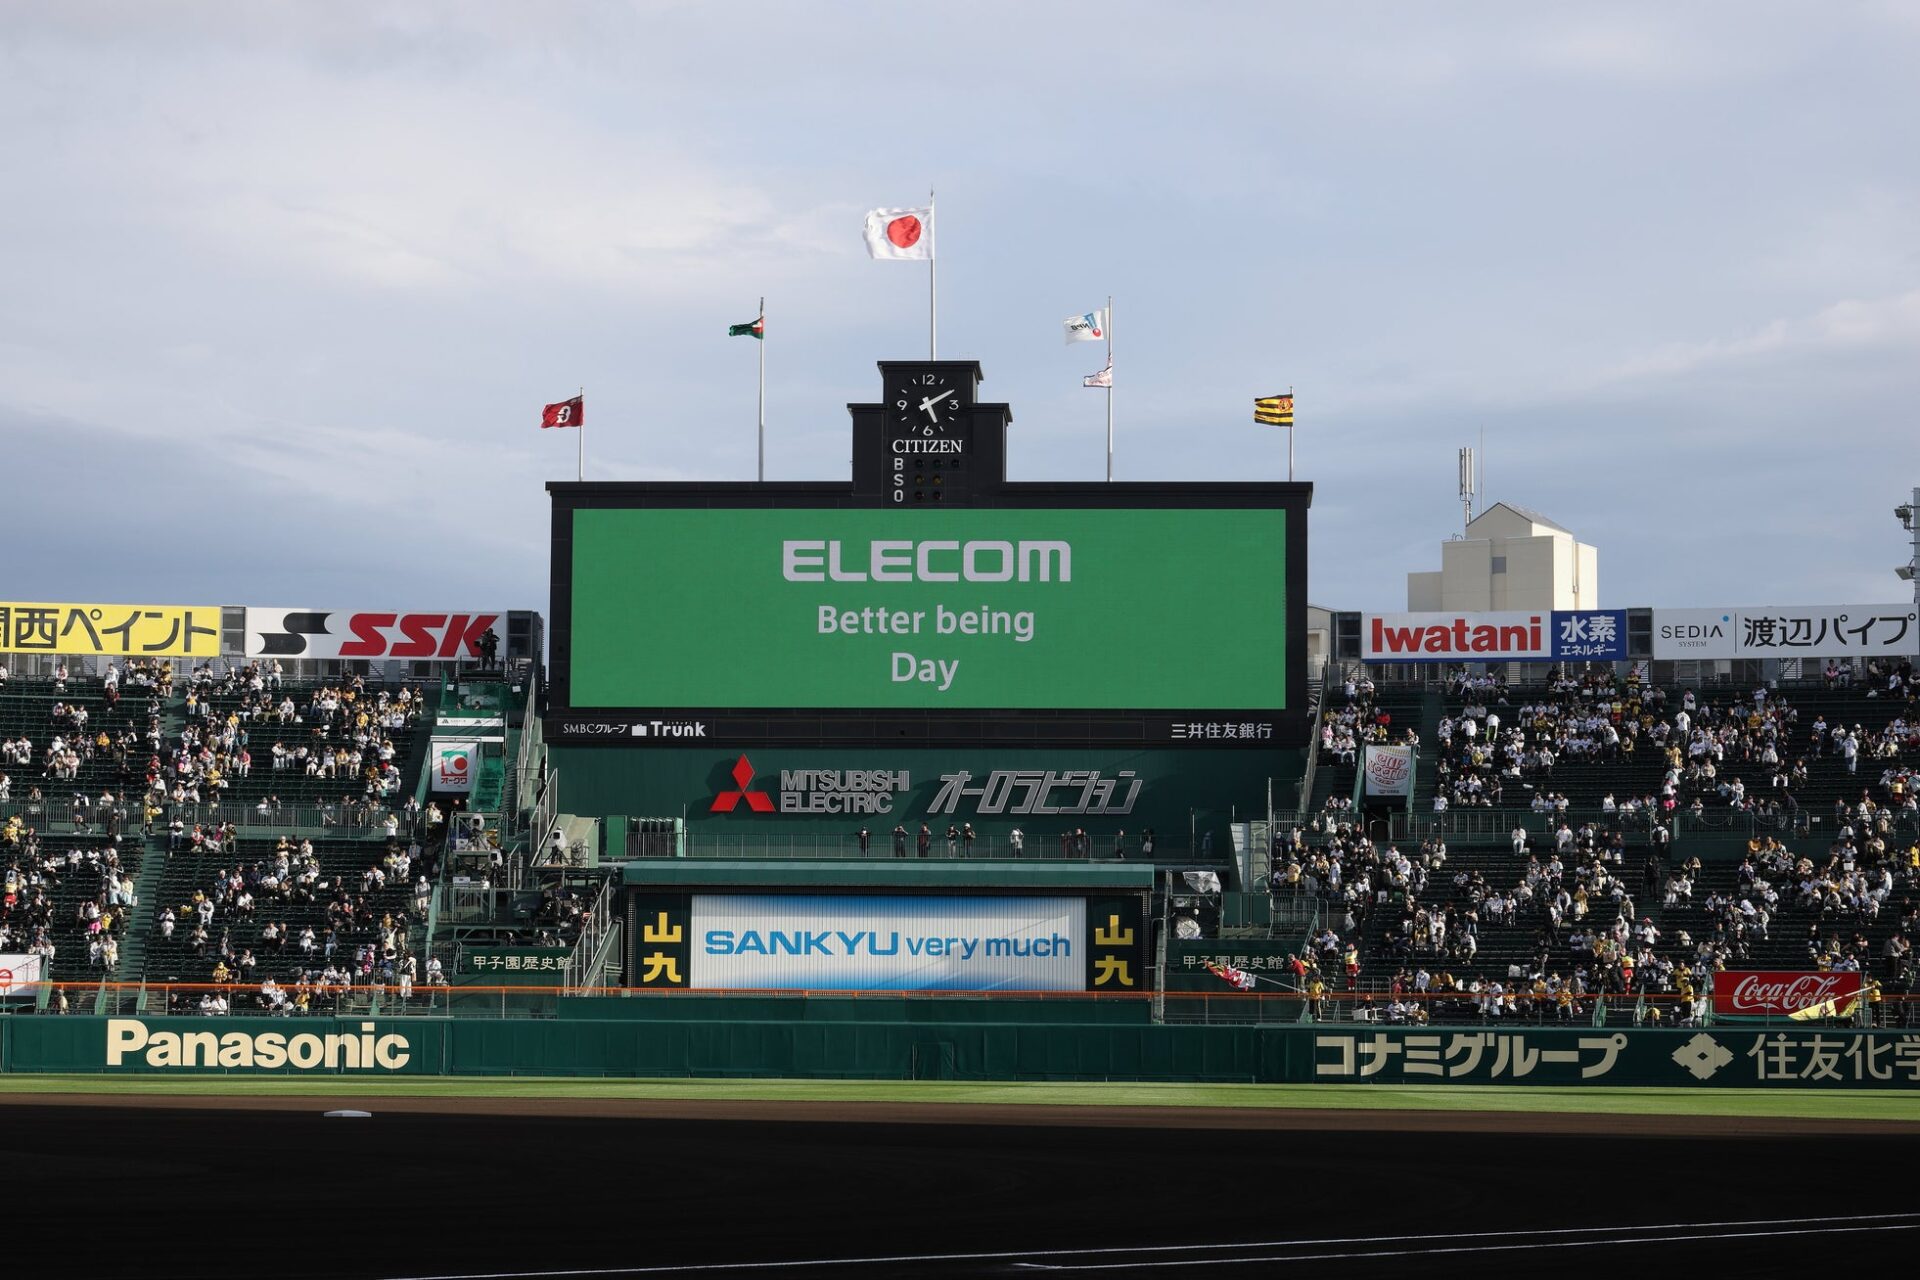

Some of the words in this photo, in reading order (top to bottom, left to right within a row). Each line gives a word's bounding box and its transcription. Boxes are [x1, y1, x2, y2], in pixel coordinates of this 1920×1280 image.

[922, 374, 935, 385] 12
[897, 400, 907, 410] 9
[949, 400, 959, 410] 3
[923, 426, 933, 436] 6
[892, 439, 963, 453] CITIZEN
[894, 458, 904, 470] B
[894, 474, 904, 486] S
[783, 540, 1071, 582] ELECOM
[0, 607, 217, 653] 西ペイント
[339, 613, 499, 657] SSK
[818, 606, 925, 634] Better
[936, 604, 1034, 642] being
[1372, 616, 1541, 653] Iwatani
[1561, 615, 1616, 642] 水素
[1661, 625, 1723, 639] SEDIA
[1744, 613, 1917, 648] 渡辺パイプ
[1560, 644, 1616, 656] エネルギー
[892, 652, 959, 691] Day
[563, 724, 628, 734] SMBCグループ
[650, 721, 706, 737] Trunk
[1171, 722, 1272, 739] 三井住友銀行
[781, 770, 910, 792] MITSUBISHI
[927, 771, 1143, 814] オーロラビジョン
[781, 792, 893, 813] ELECTRIC
[643, 912, 682, 983] 山九
[705, 930, 899, 956] SANKYU
[906, 937, 978, 960] very
[986, 933, 1070, 957] much
[1094, 915, 1134, 986] 山九
[473, 956, 573, 970] 甲子園歴史館
[1732, 975, 1842, 1010] Coca-Cola
[106, 1019, 410, 1069] Panasonic
[1316, 1033, 1628, 1078] コナミグループ
